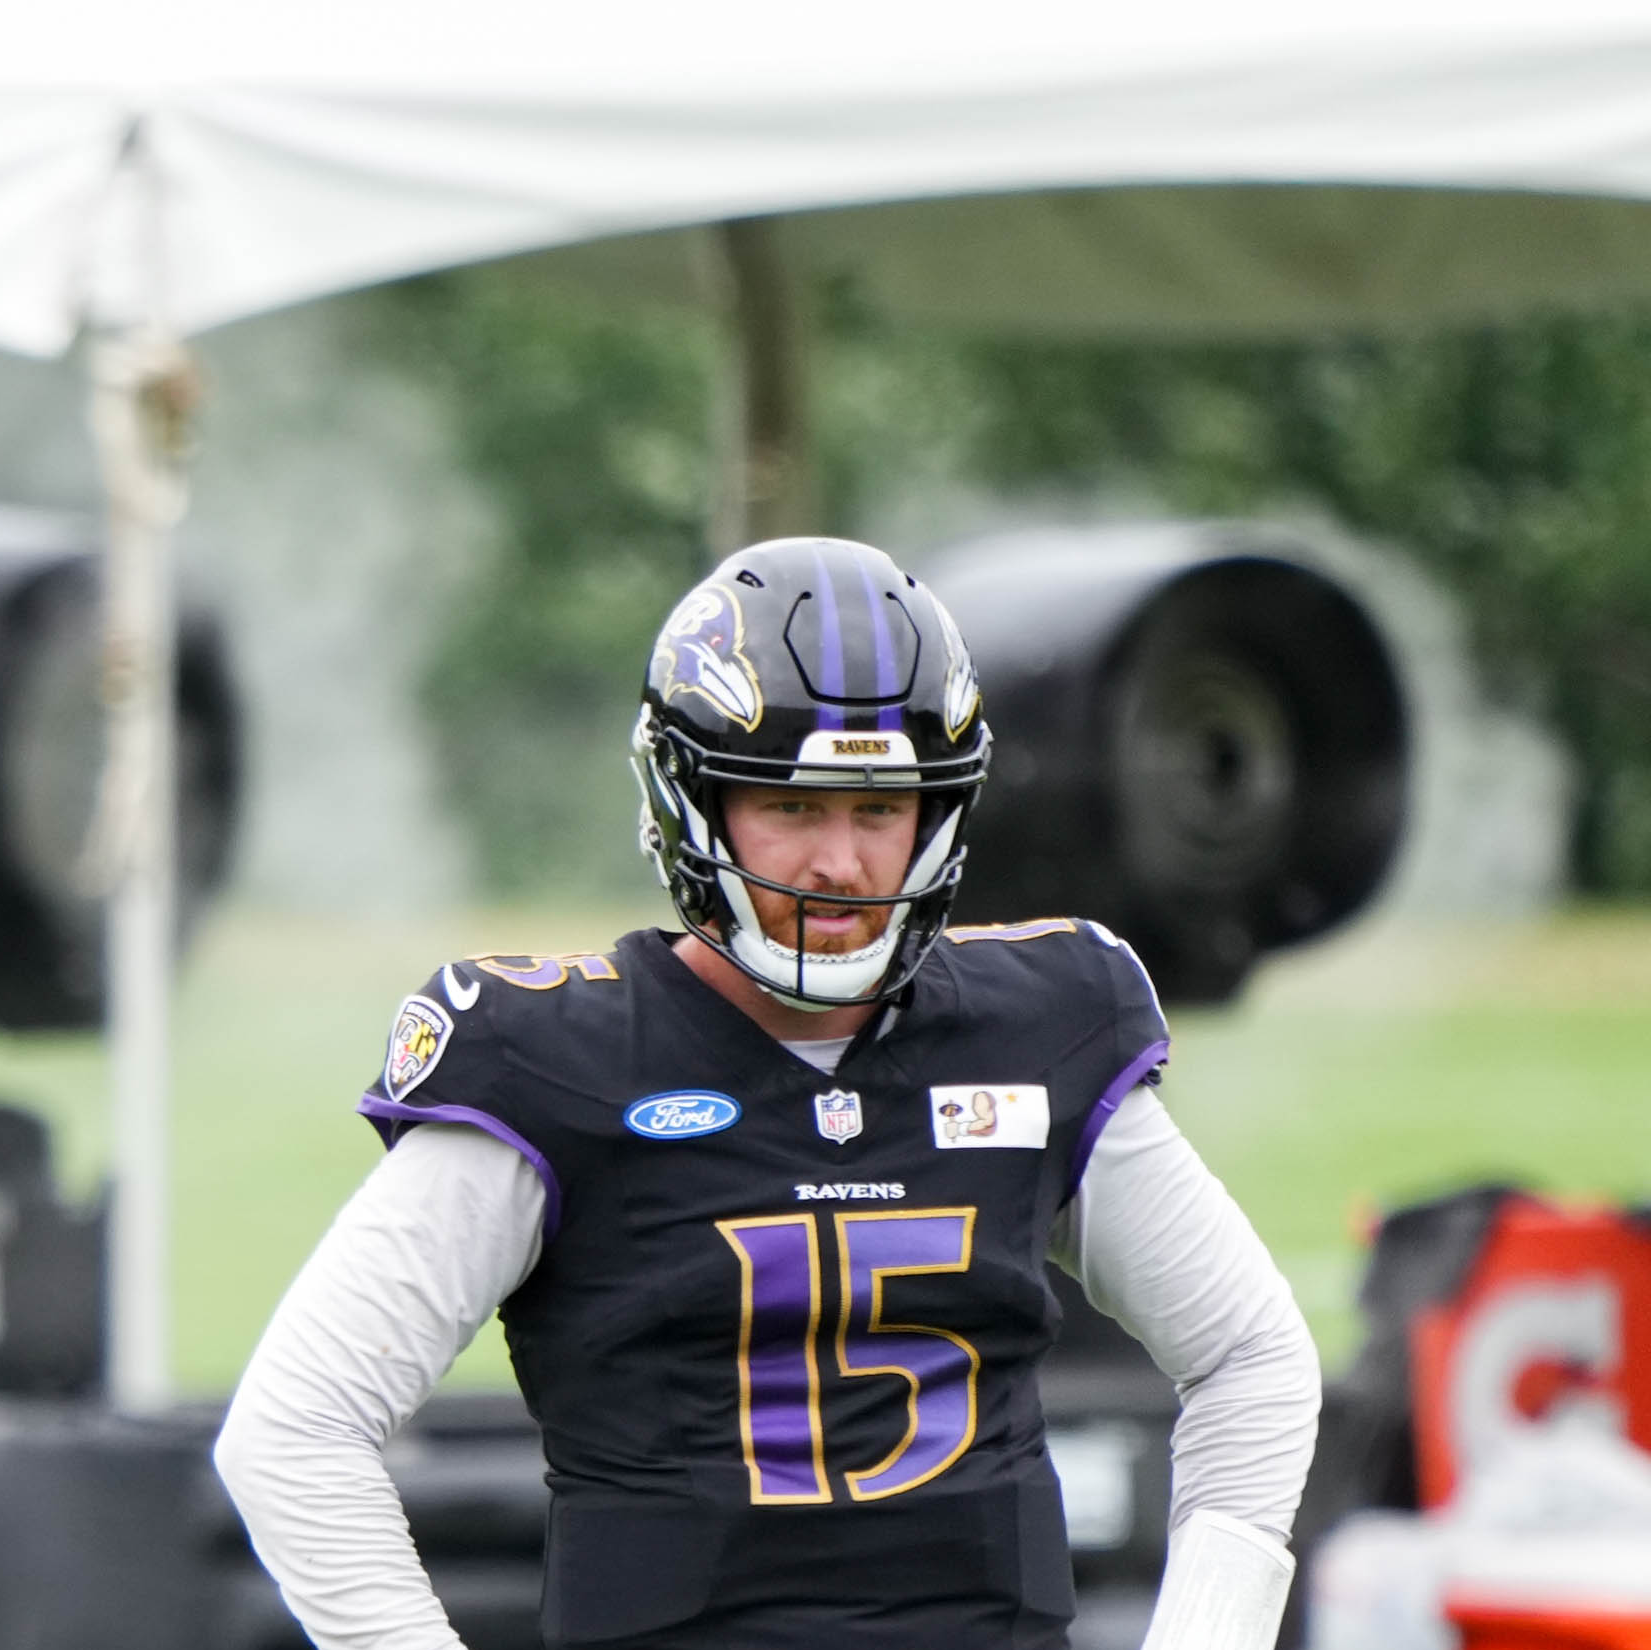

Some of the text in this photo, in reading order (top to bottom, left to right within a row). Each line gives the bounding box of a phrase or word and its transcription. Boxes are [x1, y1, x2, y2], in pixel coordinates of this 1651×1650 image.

[831, 739, 891, 755] RAVENS
[650, 1100, 716, 1130] Ford
[826, 1112, 856, 1134] NFL
[794, 1183, 907, 1200] RAVENS
[714, 1206, 978, 1506] 15
